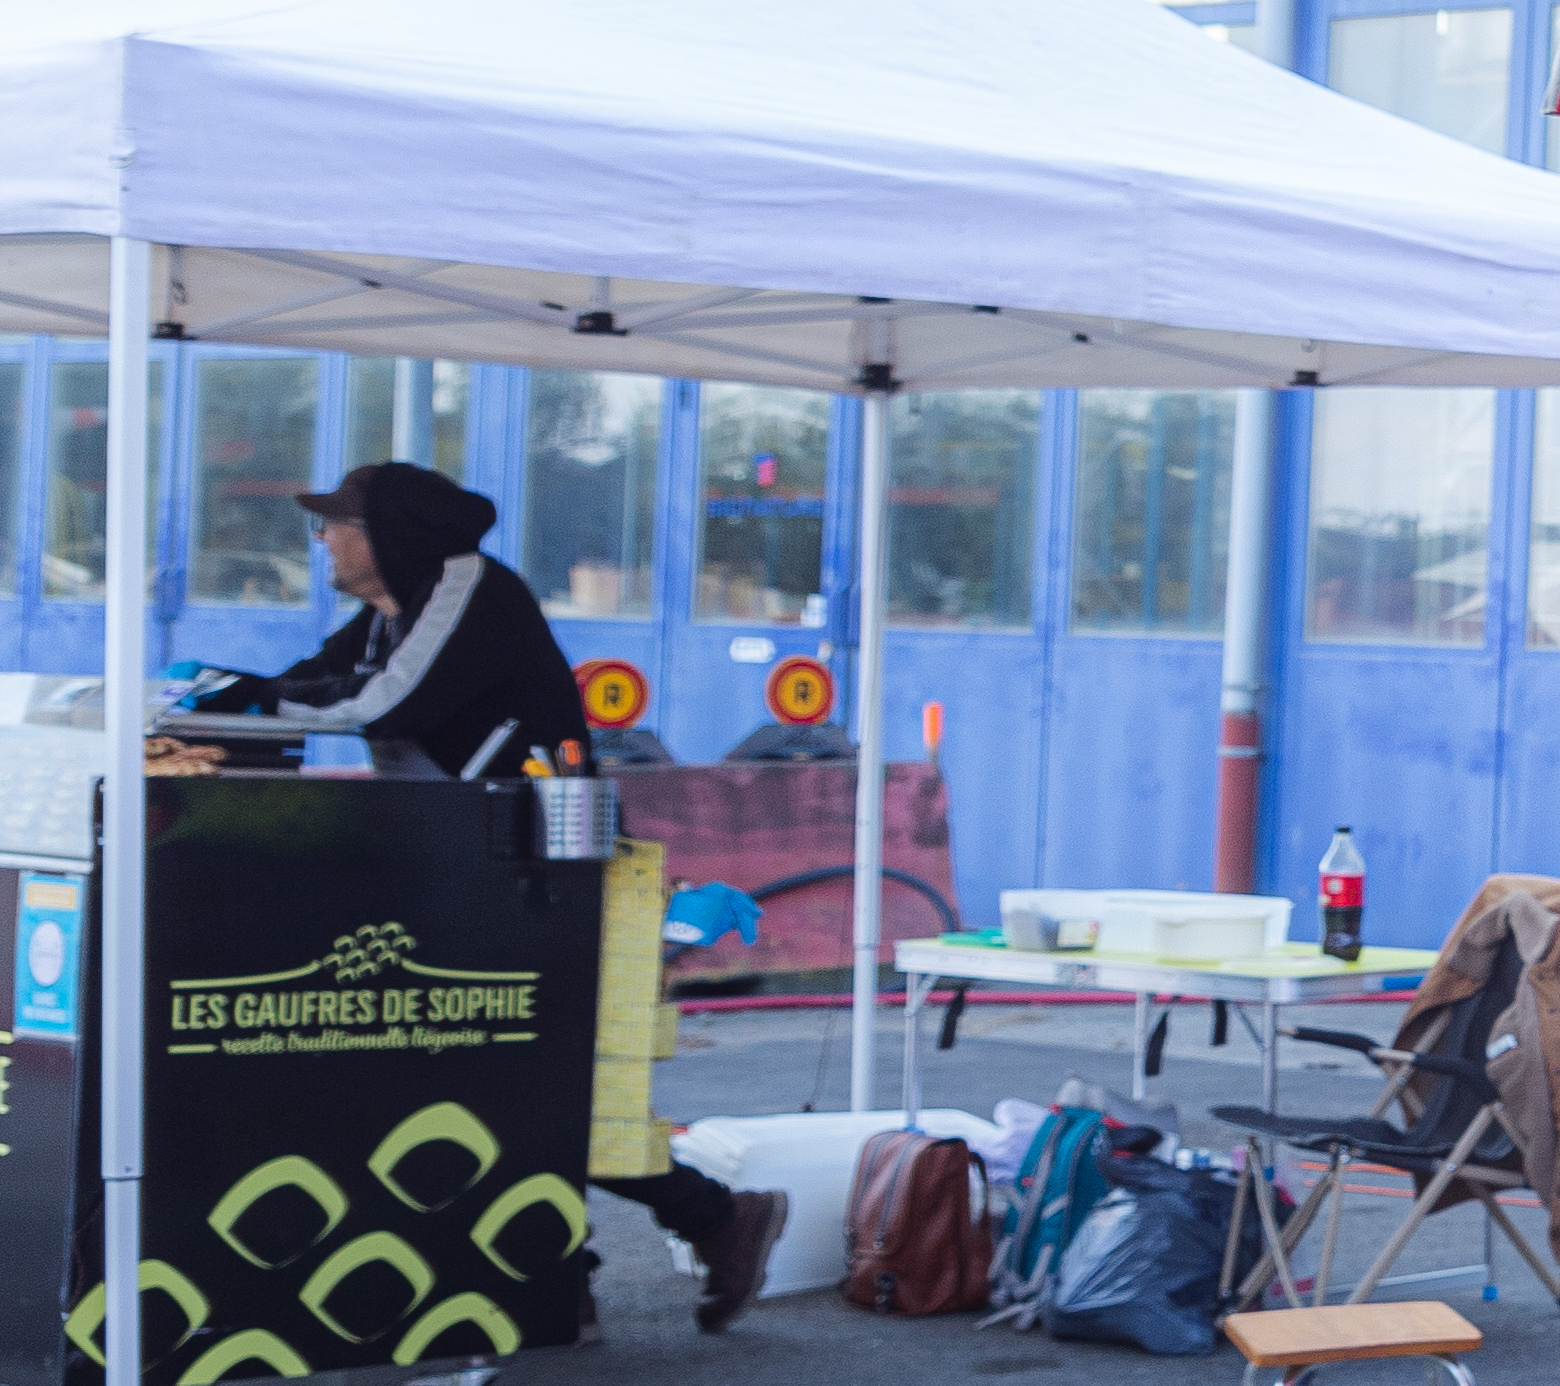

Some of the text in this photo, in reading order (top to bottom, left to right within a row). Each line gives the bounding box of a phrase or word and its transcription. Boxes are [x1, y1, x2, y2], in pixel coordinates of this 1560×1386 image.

[171, 985, 537, 1030] LES GAUFRES DE SOPHIE
